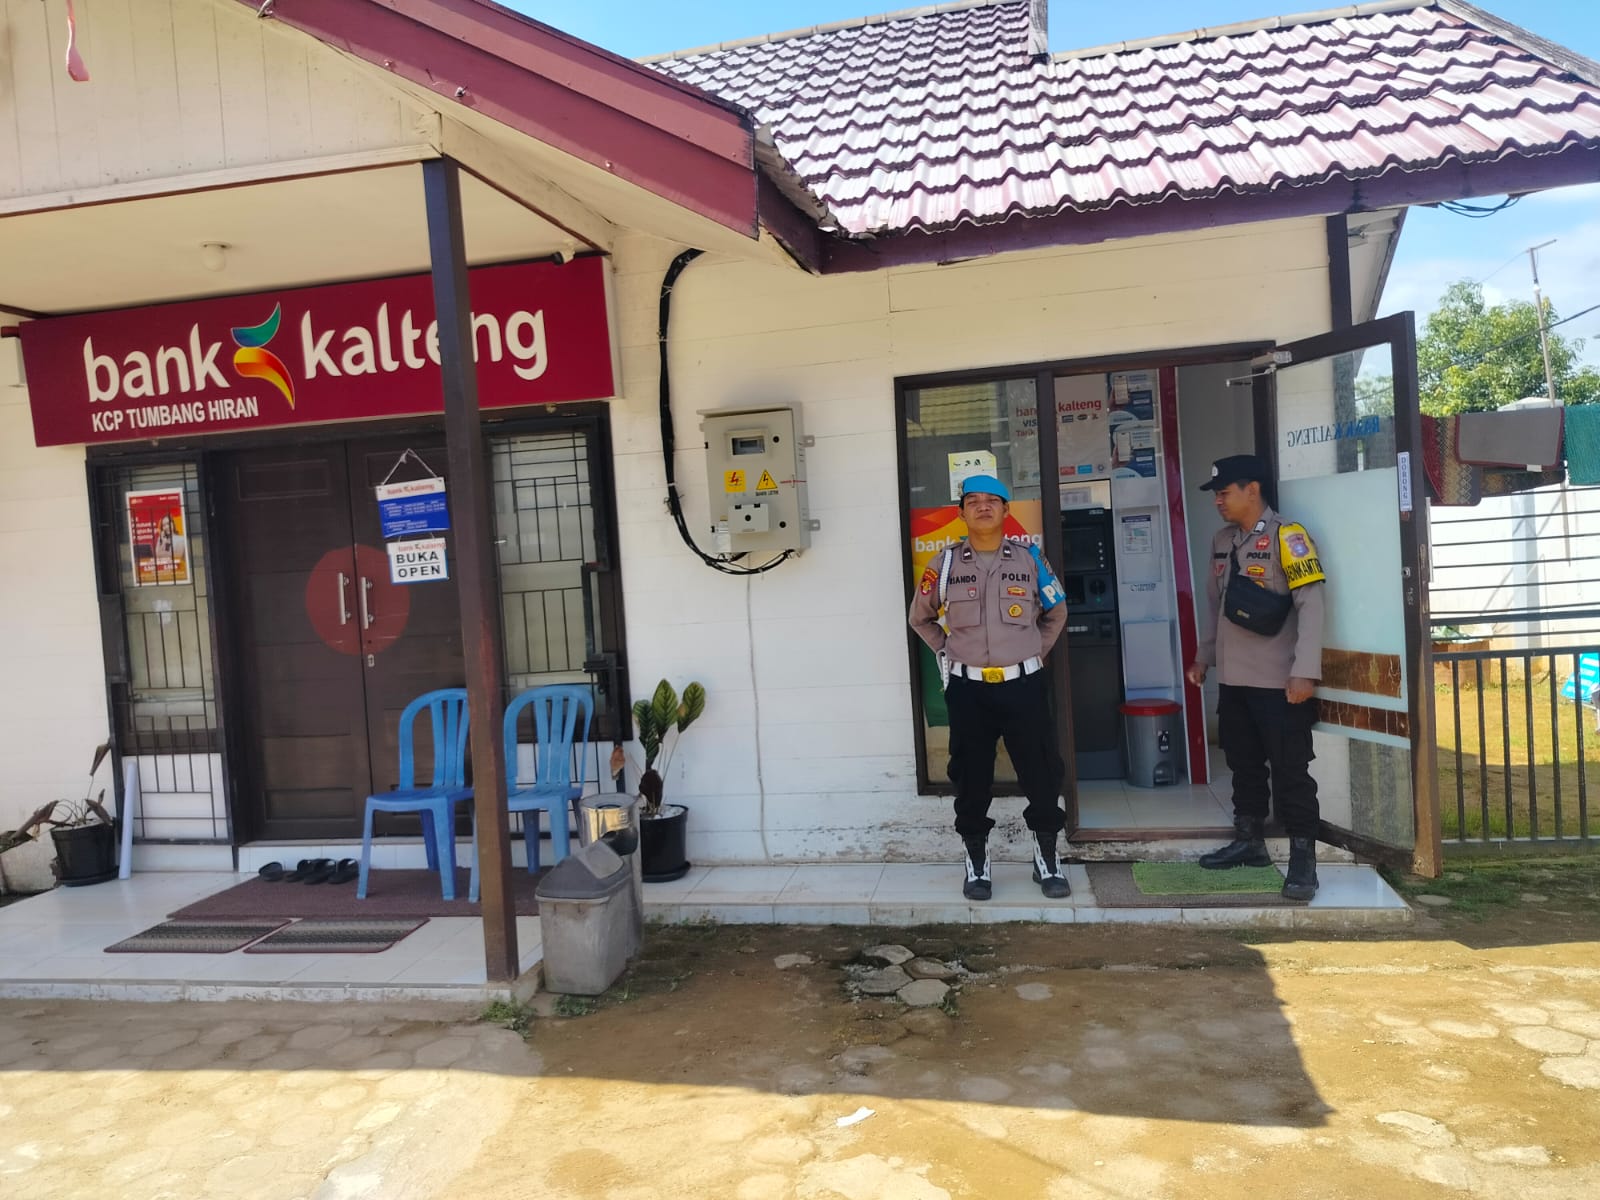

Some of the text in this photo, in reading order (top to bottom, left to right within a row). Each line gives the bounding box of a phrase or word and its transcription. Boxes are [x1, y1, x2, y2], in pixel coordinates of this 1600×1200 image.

[83, 323, 231, 402] bank
[92, 396, 259, 432] KCP TUMBANG HIRAN
[1016, 399, 1101, 417] ban kalteng
[1023, 418, 1040, 428] VIS
[396, 551, 439, 564] BUKA
[1246, 551, 1271, 560] POLRI
[398, 565, 441, 578] OPEN
[1001, 573, 1030, 582] POLRI
